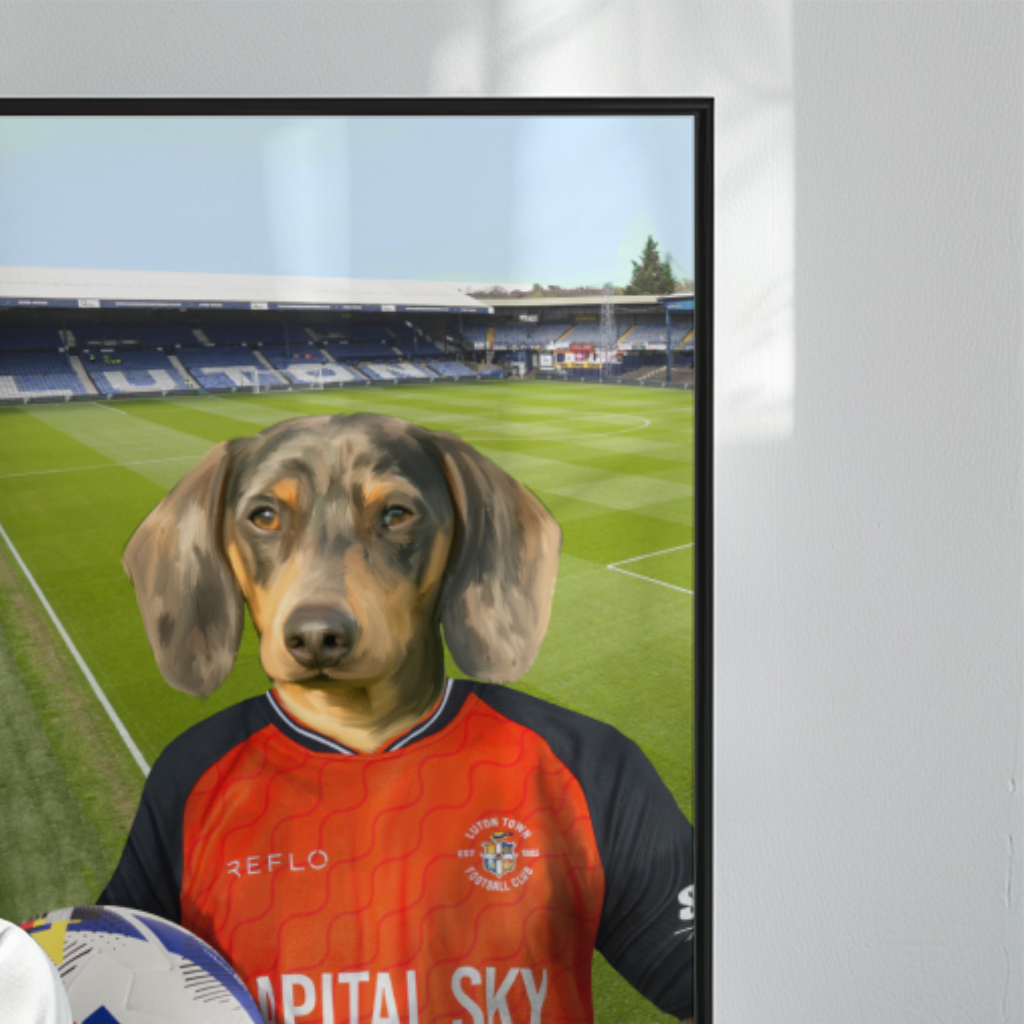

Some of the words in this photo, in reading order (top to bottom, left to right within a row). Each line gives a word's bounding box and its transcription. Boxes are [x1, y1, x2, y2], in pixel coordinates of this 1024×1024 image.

[464, 817, 499, 839] LUTON
[502, 817, 532, 839] TOWN
[226, 849, 328, 878] REFLO
[464, 866, 511, 892] FOOTBALL
[510, 866, 533, 888] CLUB
